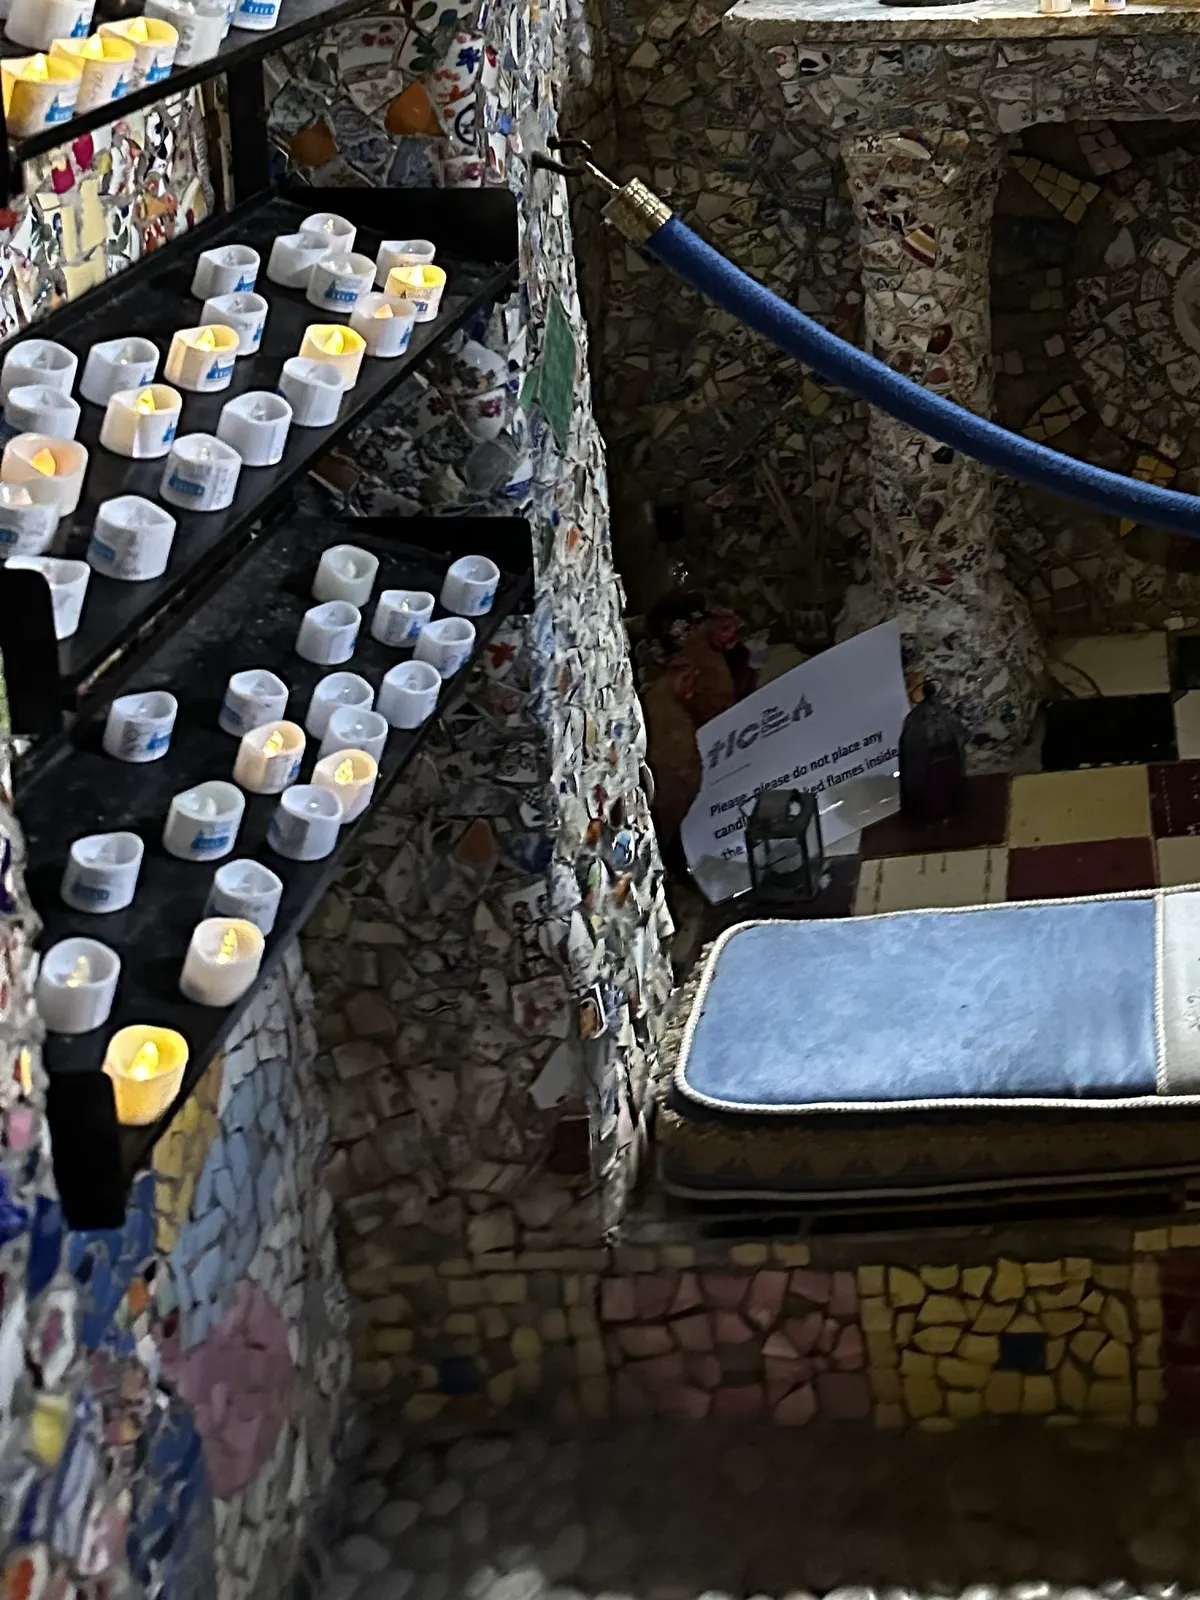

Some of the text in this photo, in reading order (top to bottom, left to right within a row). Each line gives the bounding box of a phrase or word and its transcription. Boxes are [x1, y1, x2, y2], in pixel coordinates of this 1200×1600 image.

[793, 765, 807, 779] do
[810, 754, 830, 771] not
[831, 741, 861, 764] place
[862, 731, 882, 747] any
[826, 763, 865, 787] flames
[722, 846, 744, 860] the
